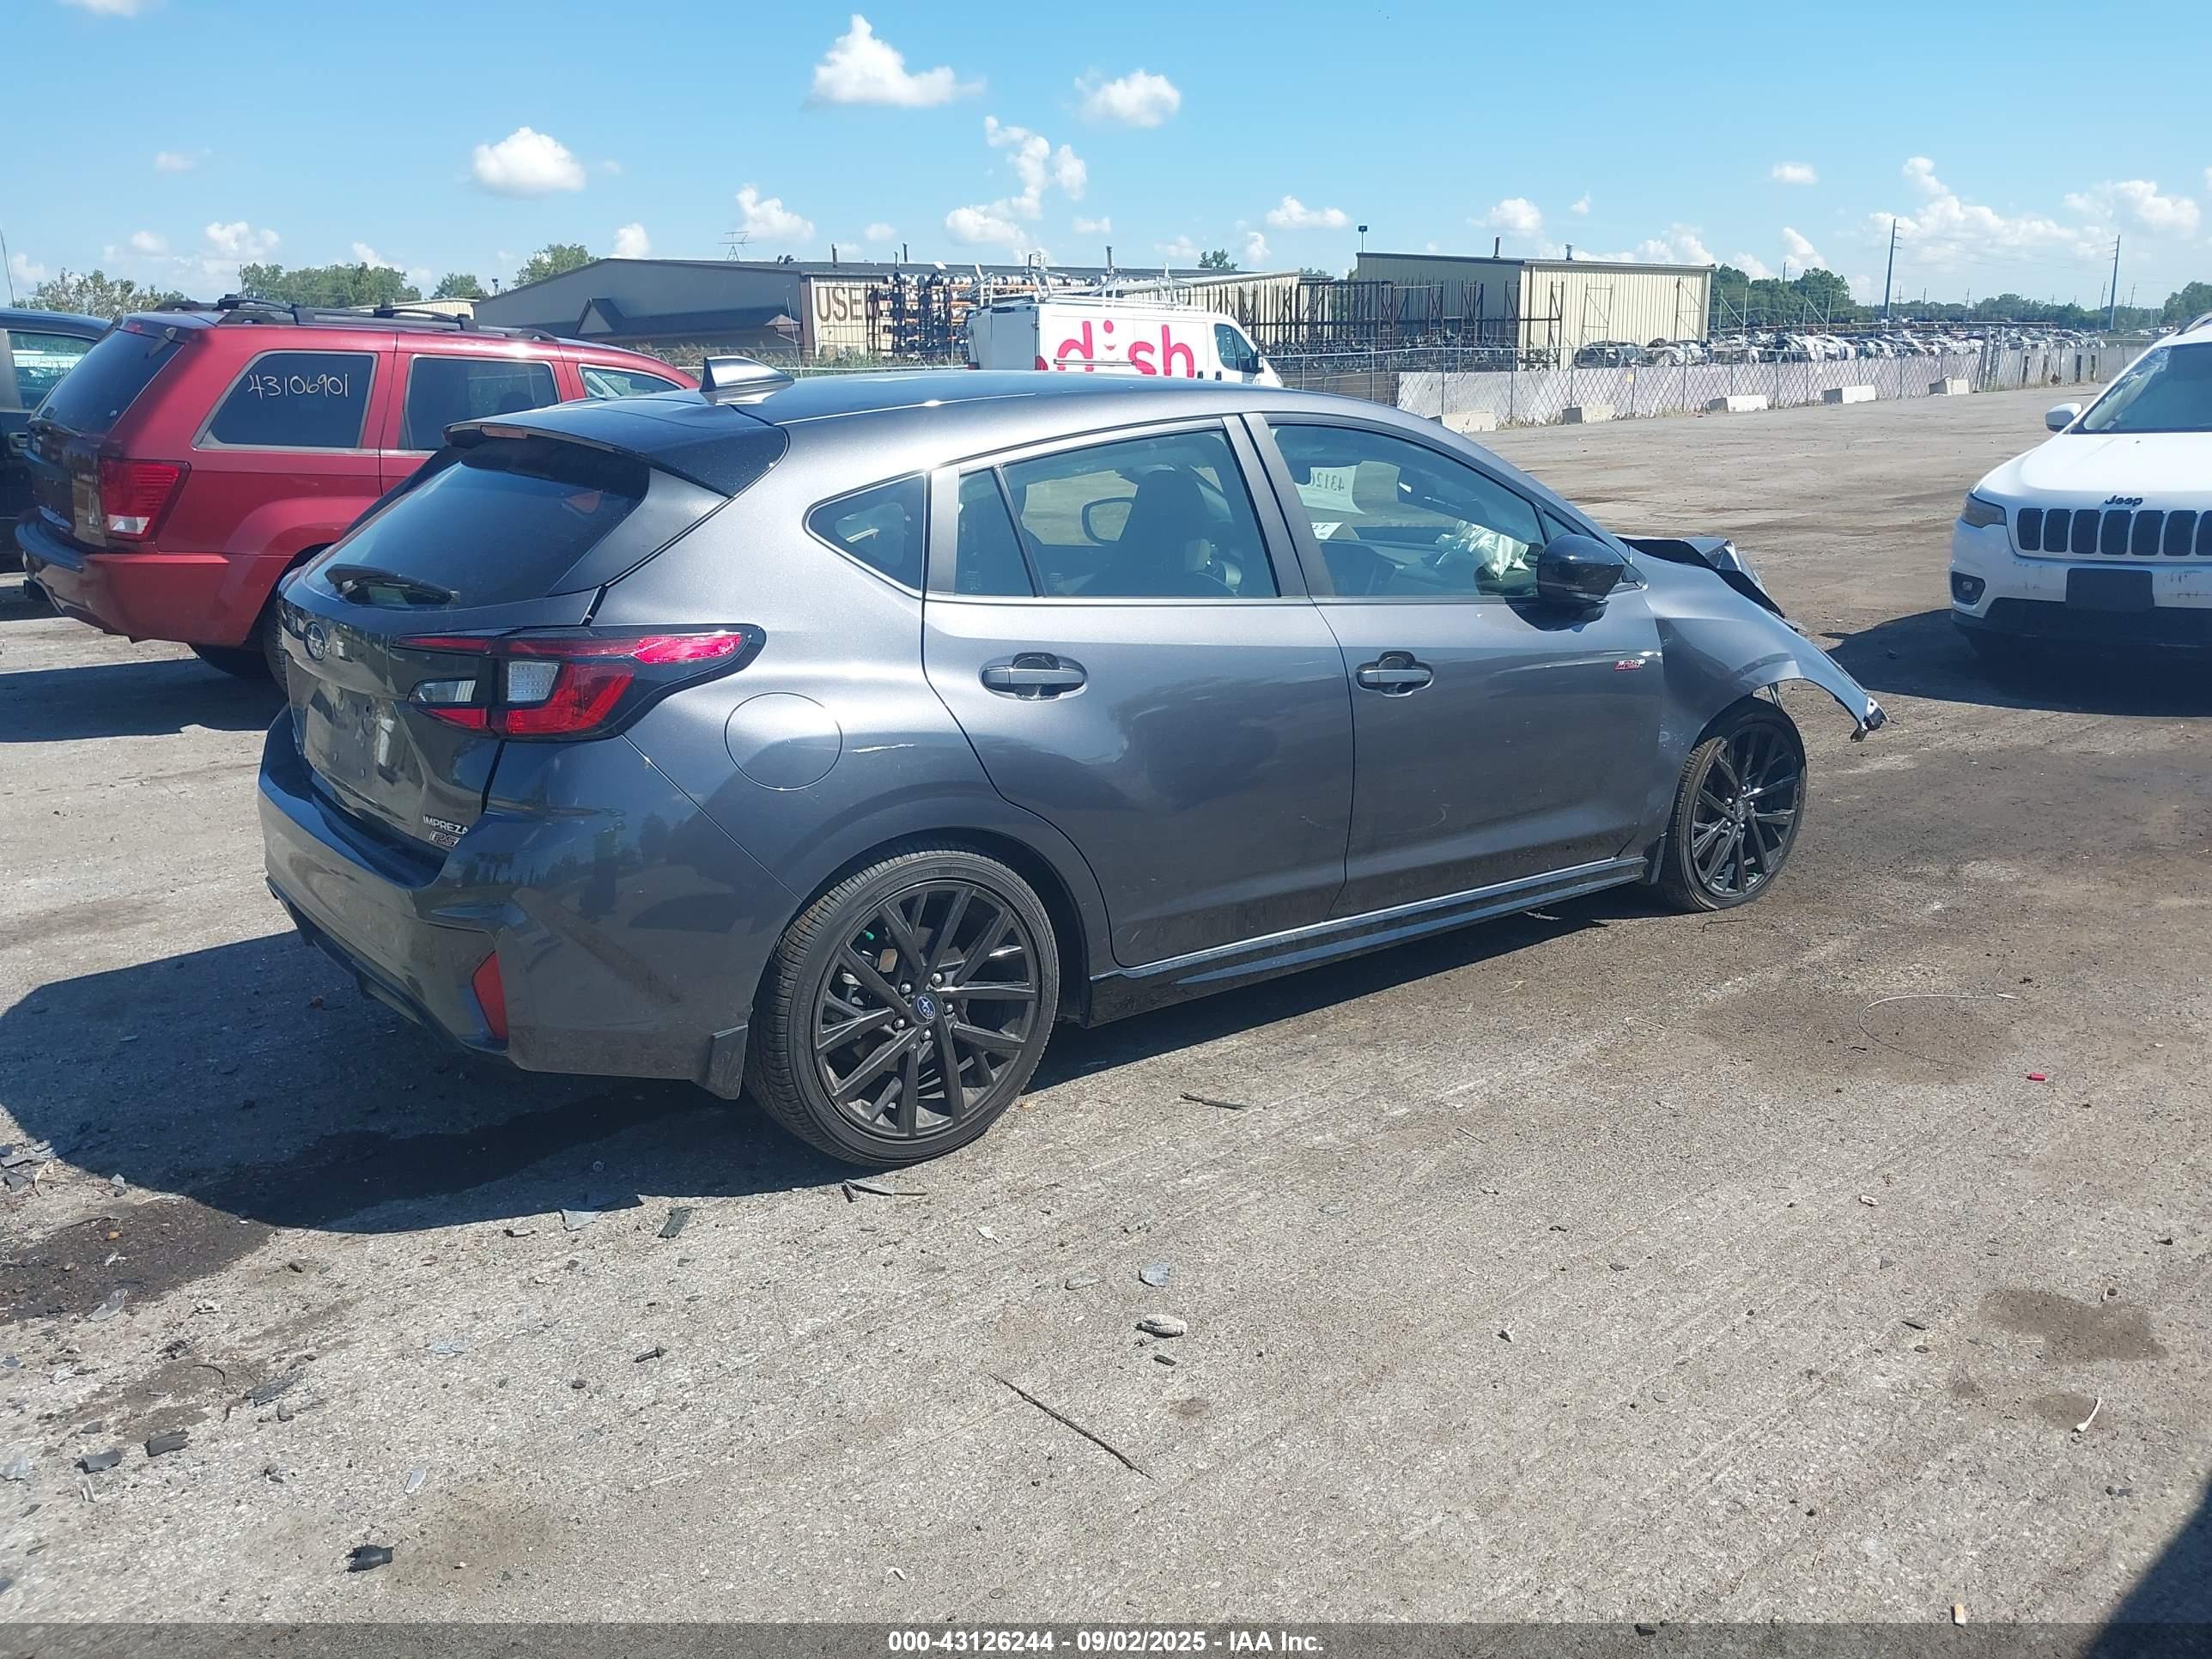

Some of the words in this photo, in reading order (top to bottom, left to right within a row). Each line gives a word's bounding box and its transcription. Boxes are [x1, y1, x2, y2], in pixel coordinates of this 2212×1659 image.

[247, 374, 349, 399] 43106901
[2104, 495, 2143, 507] Jeep
[422, 815, 469, 835] IMPREZA
